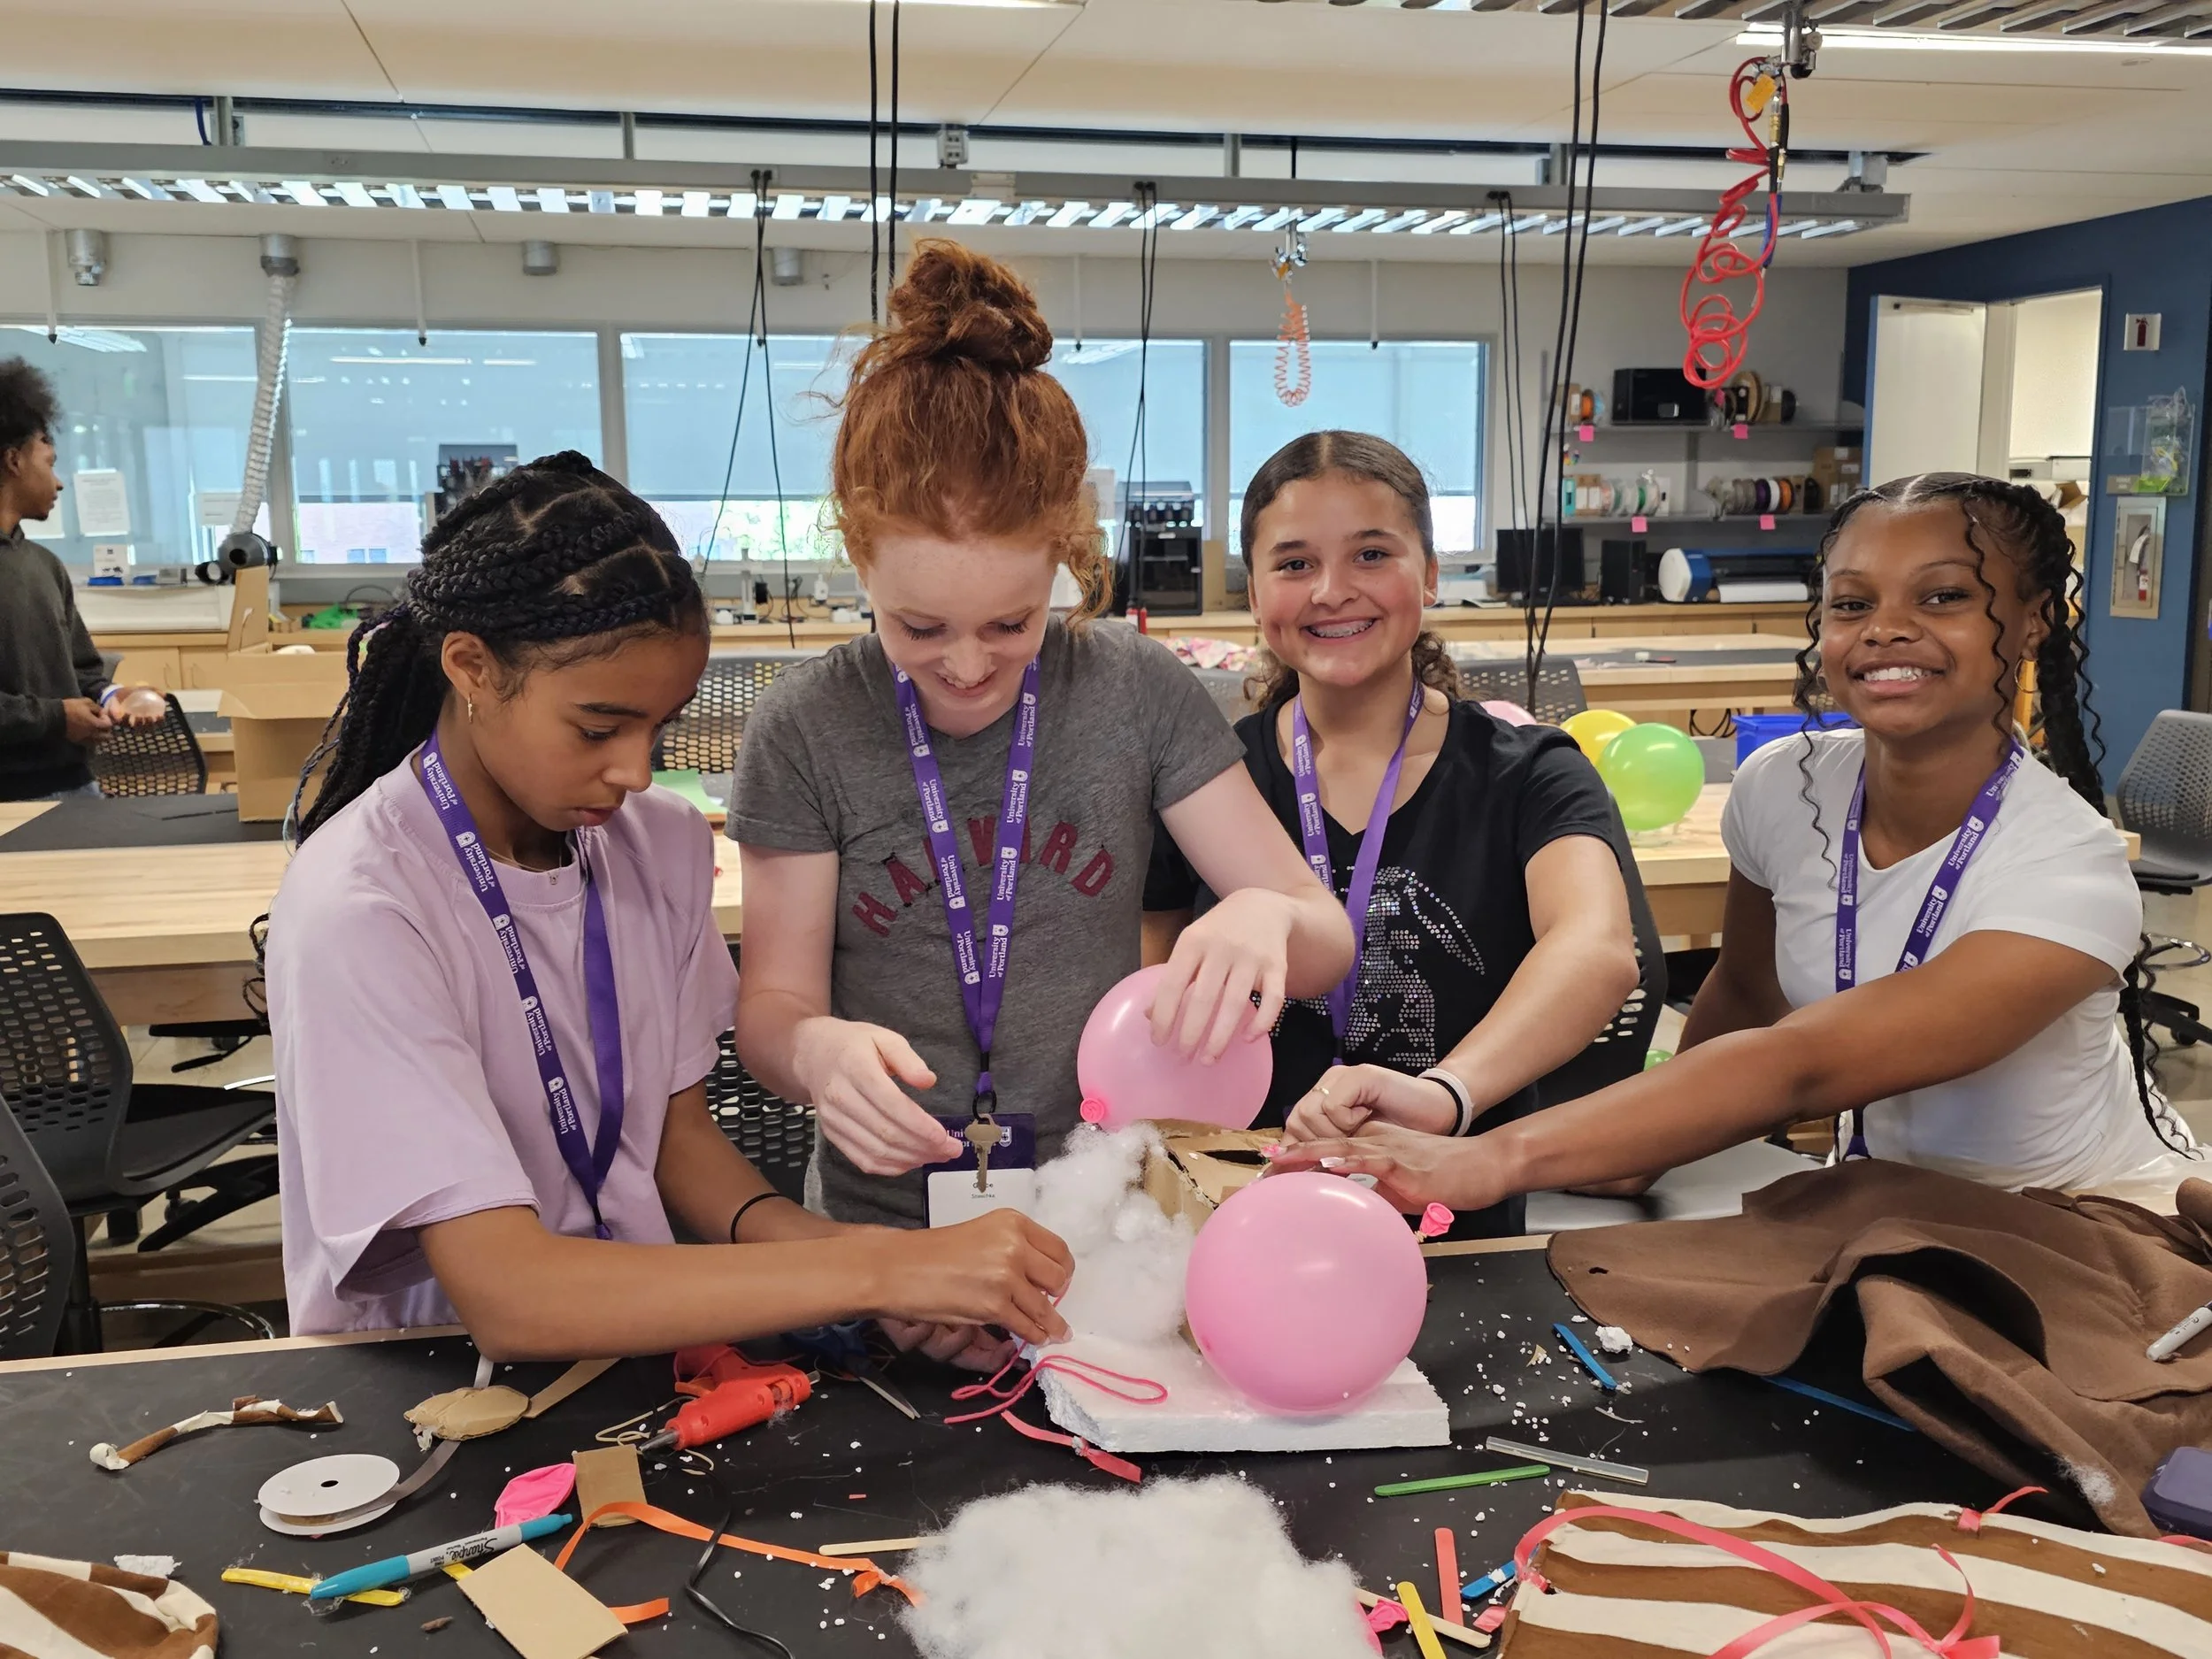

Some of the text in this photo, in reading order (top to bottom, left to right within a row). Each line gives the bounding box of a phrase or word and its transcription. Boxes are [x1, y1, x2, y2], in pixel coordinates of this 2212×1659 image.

[906, 711, 918, 746] Portland
[910, 703, 926, 745] University
[1018, 705, 1028, 746] University
[1026, 706, 1035, 741] Portland
[1302, 743, 1310, 771] Portland
[426, 767, 449, 810] University
[433, 762, 455, 800] Portland
[929, 779, 944, 819] University
[923, 787, 937, 822] Portland
[1007, 782, 1019, 823] University
[1017, 783, 1026, 818] Portland
[1310, 803, 1320, 831] Portland
[472, 842, 493, 882] Portland
[1948, 828, 1971, 866] University
[1957, 832, 1979, 865] Portland
[464, 848, 488, 893] University
[852, 814, 1116, 938] HAVRD
[941, 862, 955, 898] Portland
[948, 855, 961, 895] University
[997, 859, 1010, 901] University
[1006, 860, 1016, 895] Portland
[1916, 897, 1937, 933] University
[1927, 902, 1944, 933] Portland
[500, 931, 518, 974] University
[505, 926, 524, 965] Portland
[957, 938, 970, 973] Portland
[964, 931, 976, 971] University
[989, 937, 1001, 978] University
[997, 938, 1007, 972] Portland
[526, 1012, 545, 1056] University
[533, 1008, 550, 1044] Portland
[553, 1093, 568, 1134] University
[559, 1088, 575, 1125] Portland
